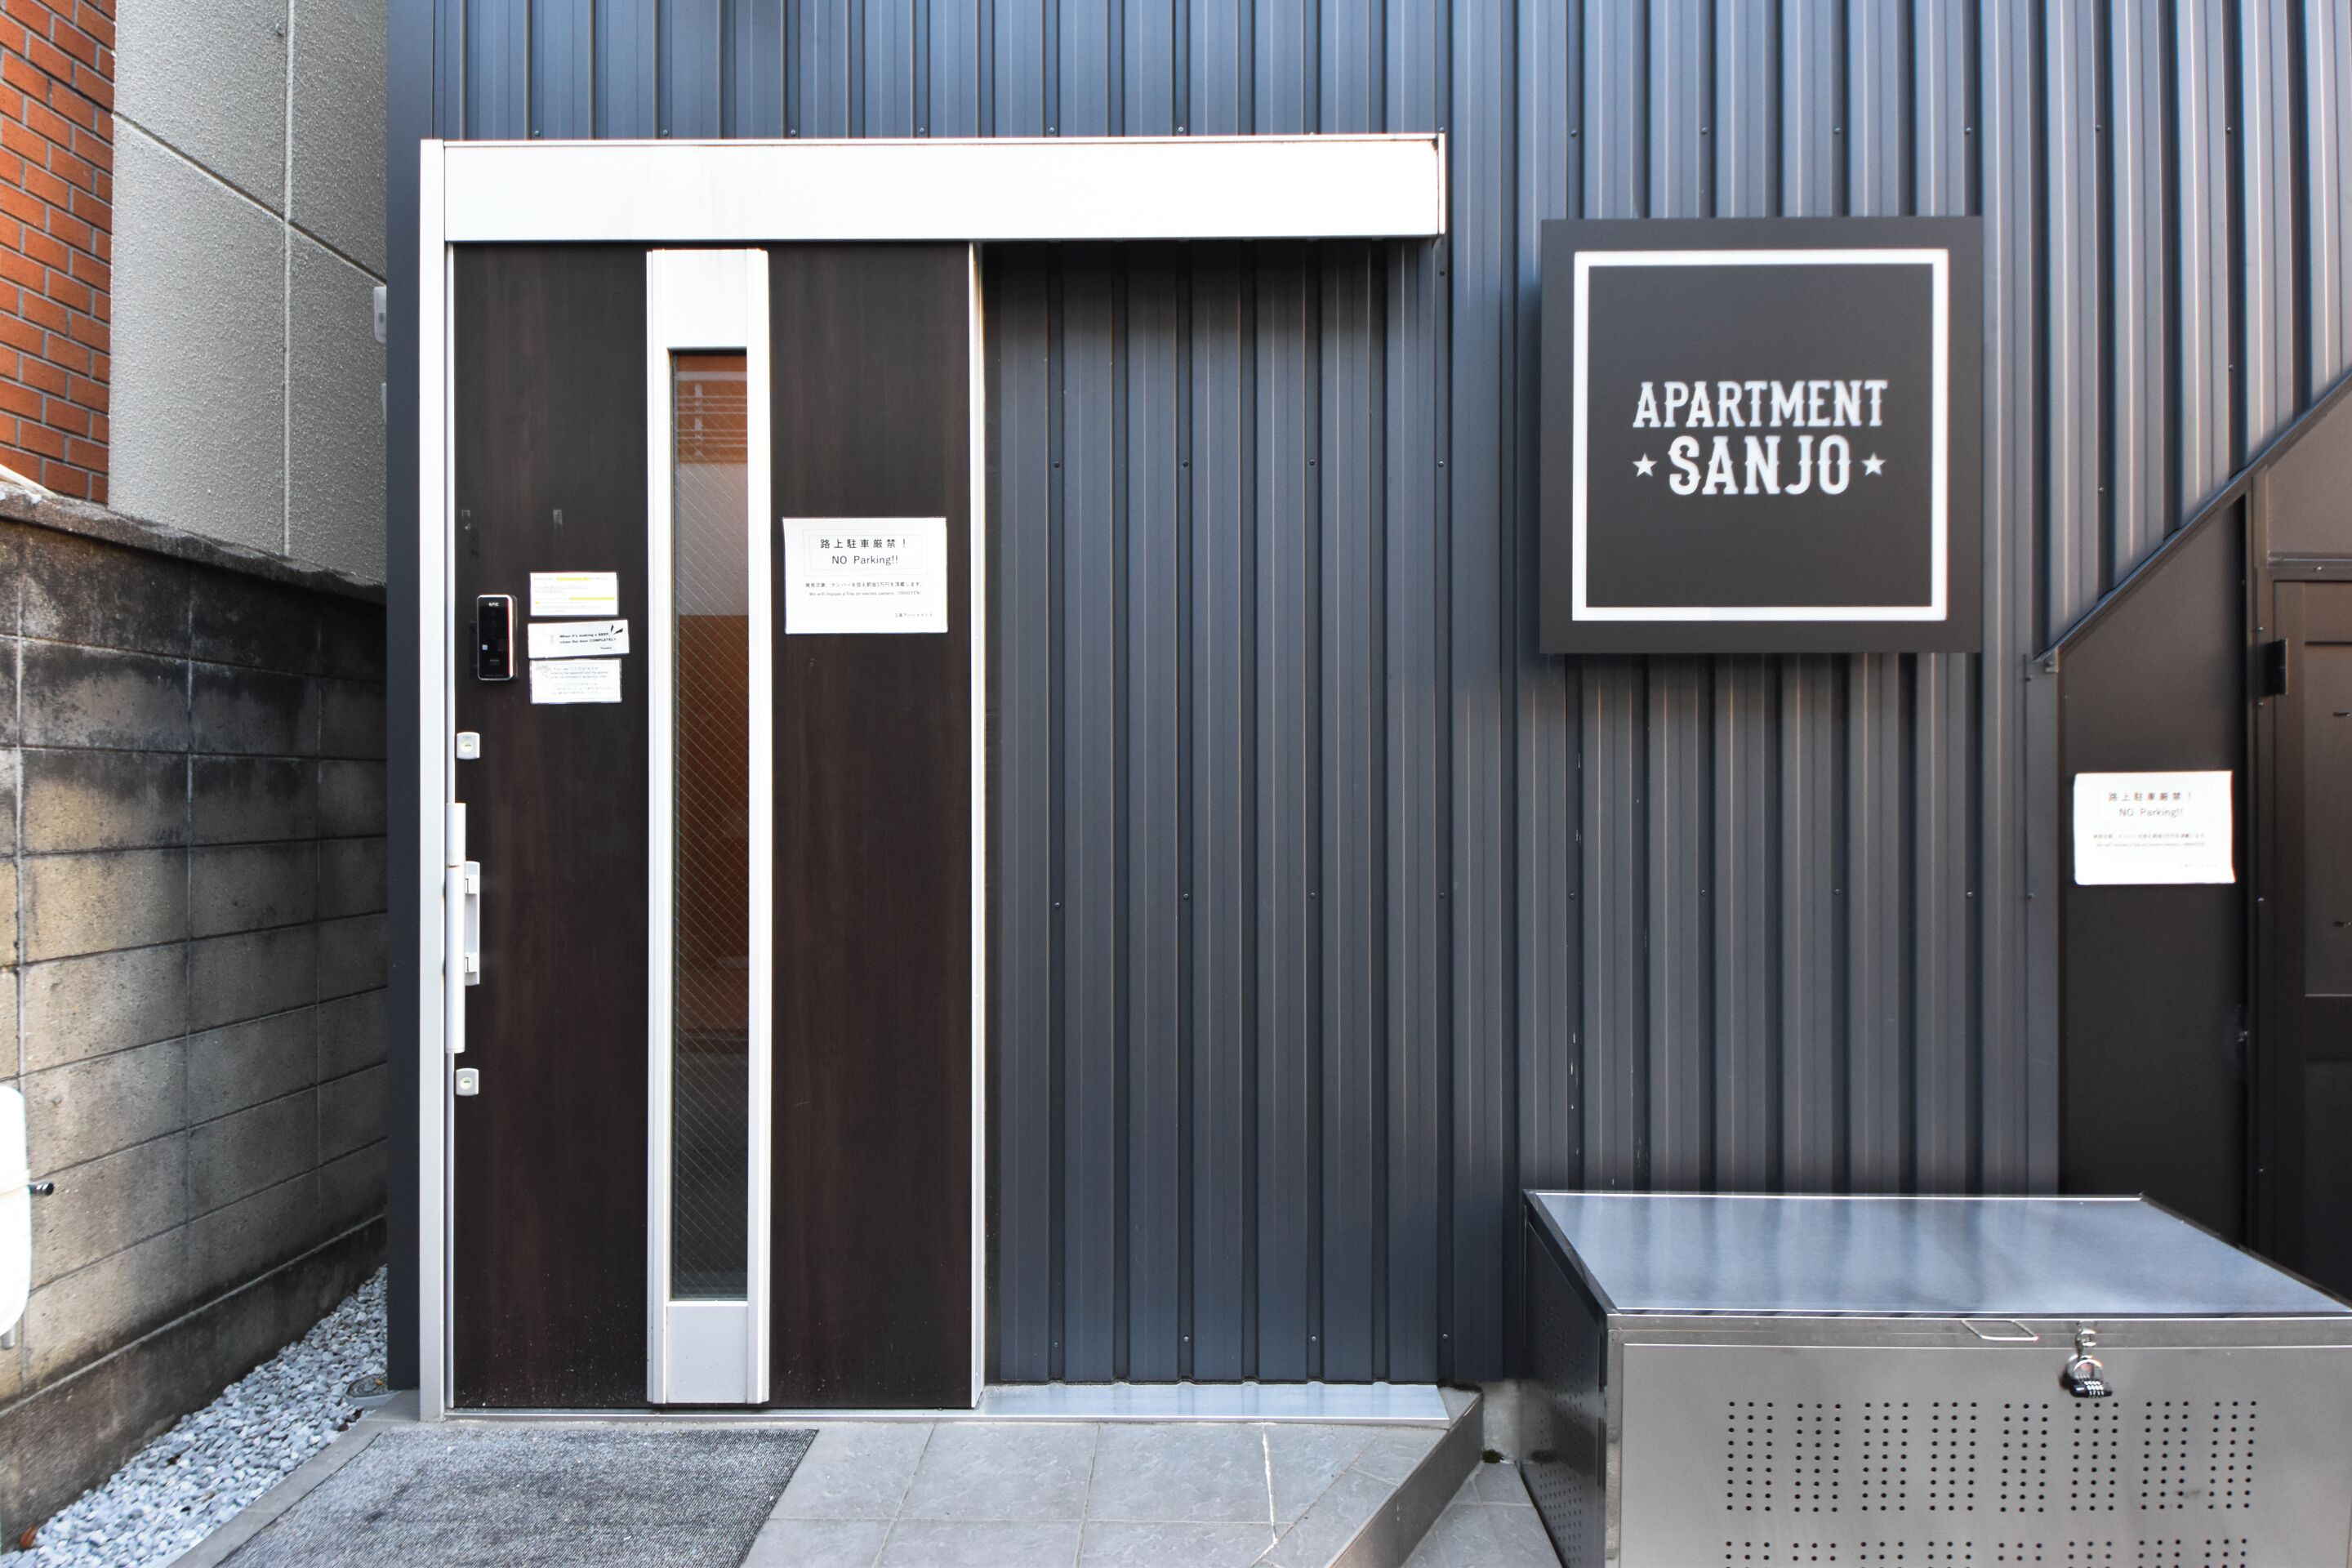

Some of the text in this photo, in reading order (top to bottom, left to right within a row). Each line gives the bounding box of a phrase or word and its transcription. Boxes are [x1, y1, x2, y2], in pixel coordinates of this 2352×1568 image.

[1633, 380, 1888, 428] APARTMENT
[1668, 434, 1851, 495] SANJO
[831, 555, 898, 566] NO Parking!!
[2119, 808, 2184, 818] NO Parking!!
